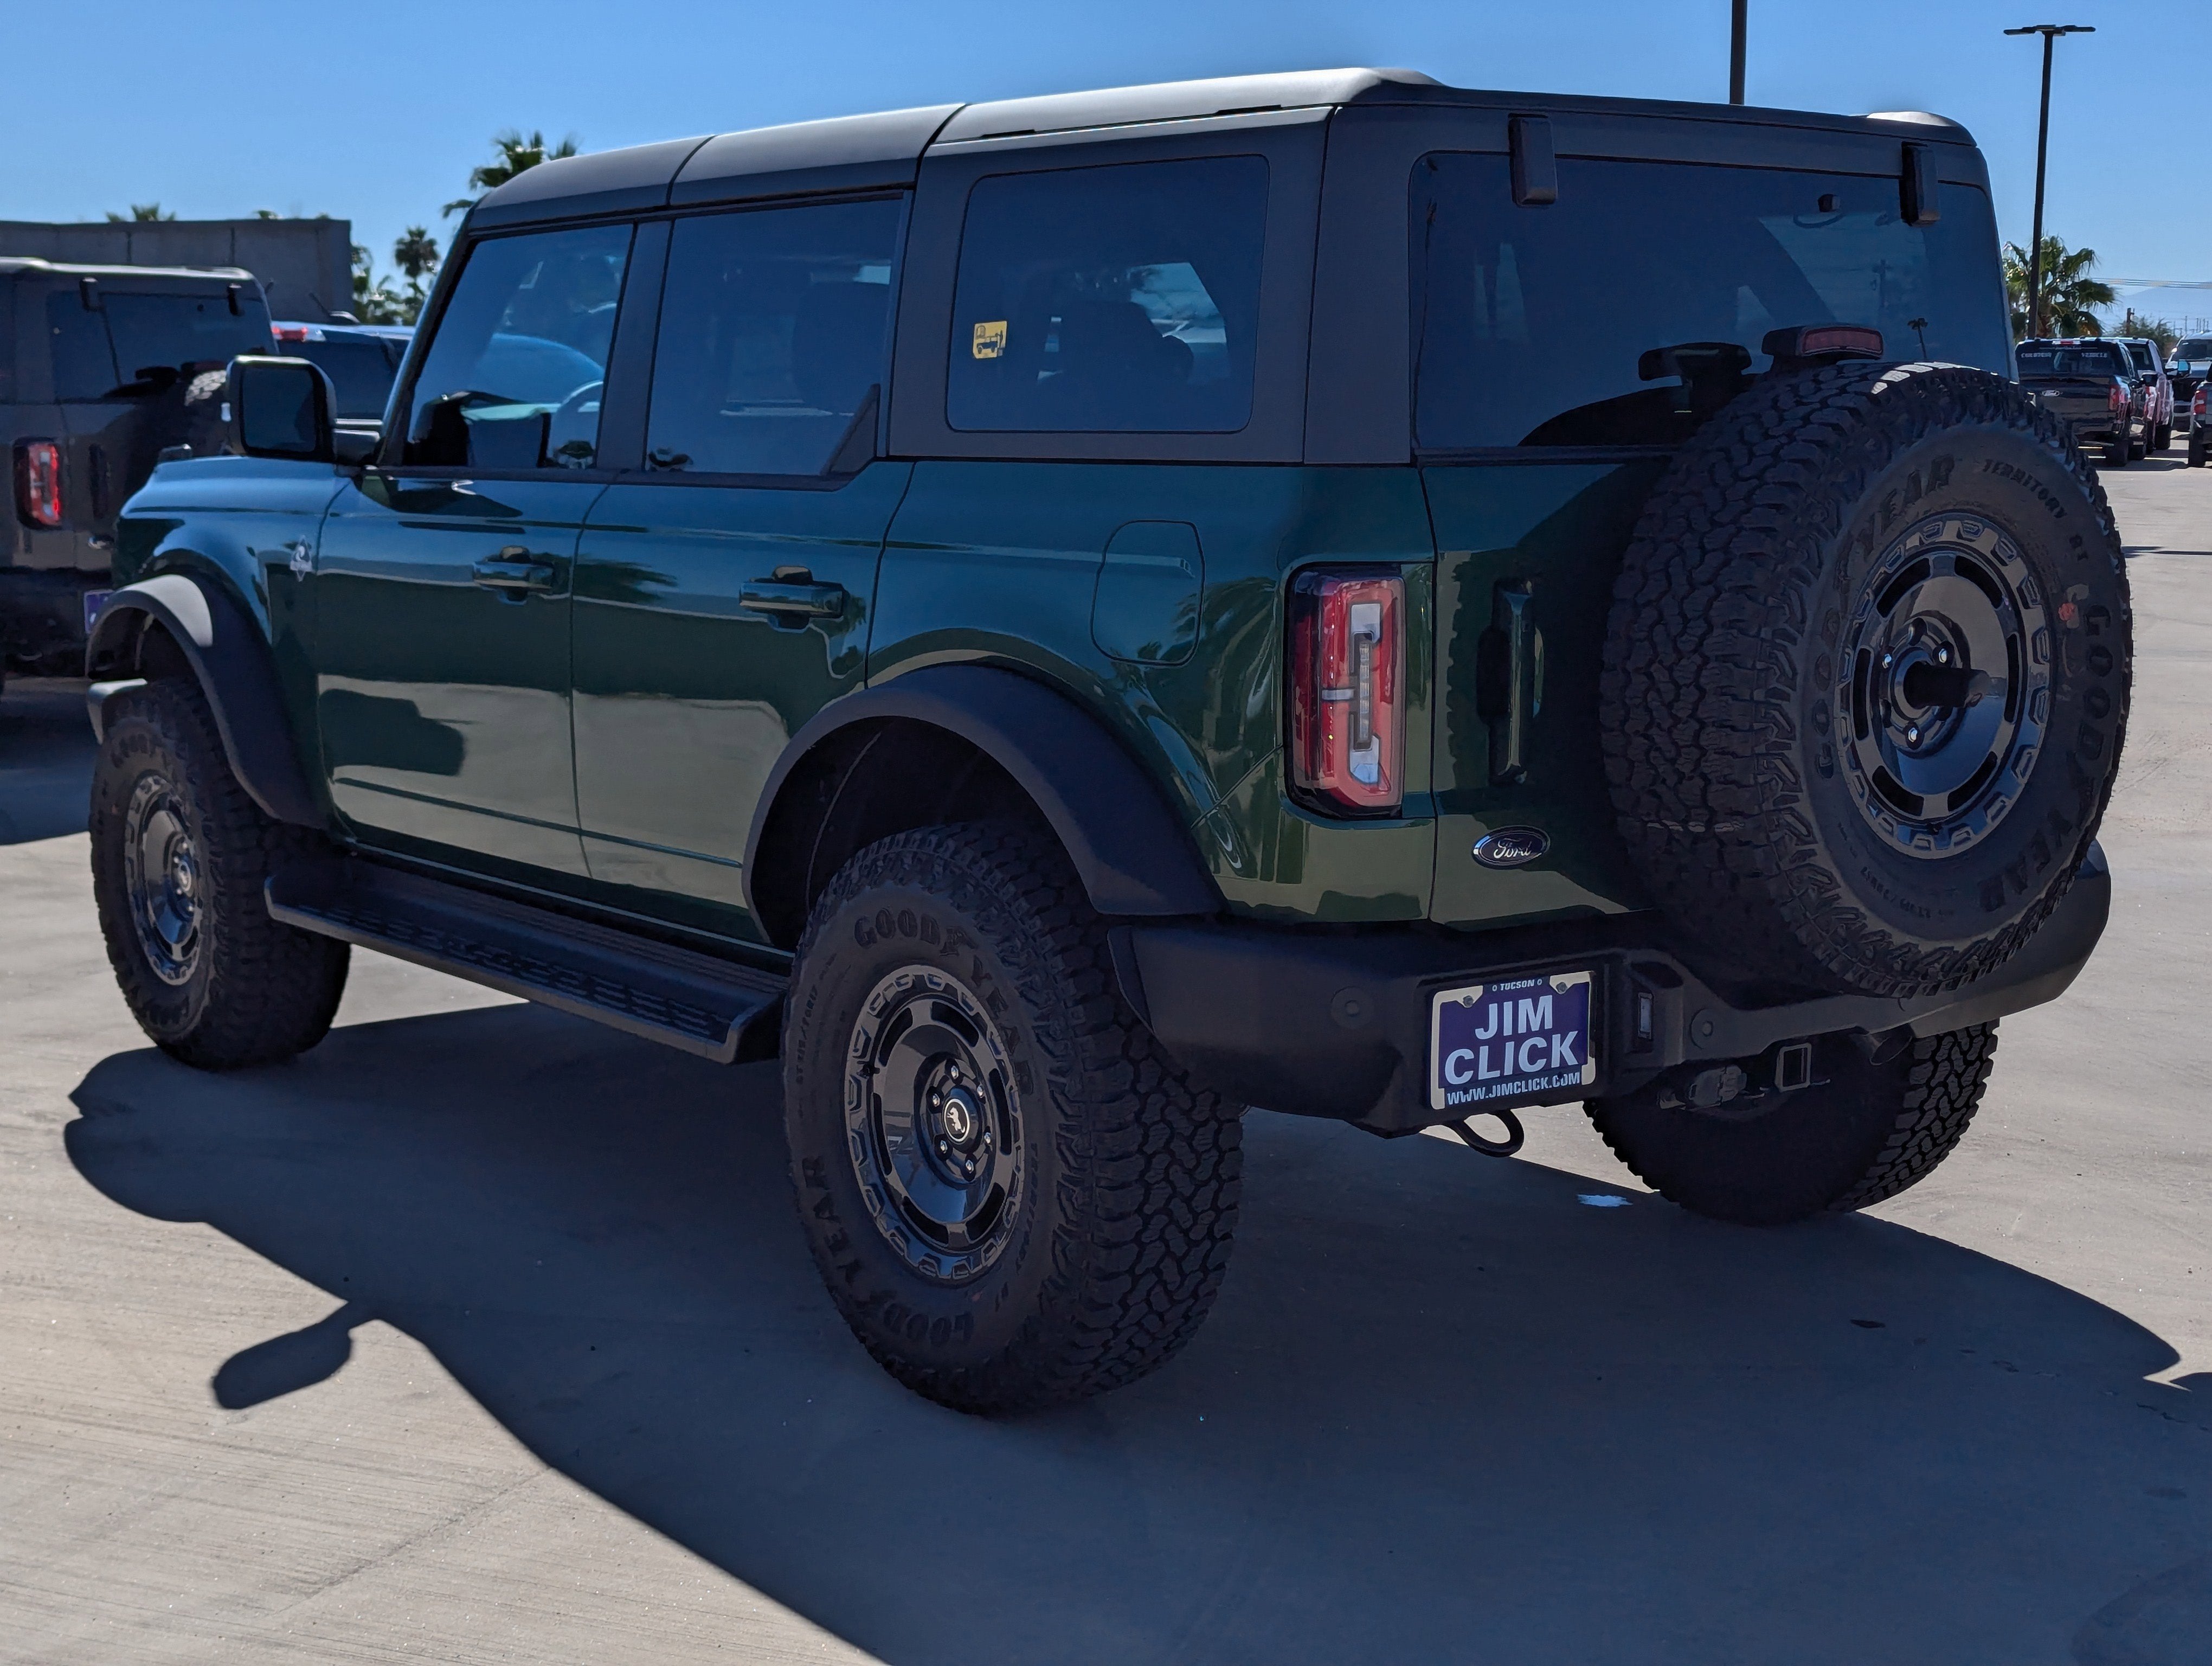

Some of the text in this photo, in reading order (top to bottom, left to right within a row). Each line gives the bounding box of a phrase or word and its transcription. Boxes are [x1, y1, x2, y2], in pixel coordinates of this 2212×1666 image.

[1494, 838, 1533, 858] Ford
[1500, 979, 1534, 991] TUCSON
[1475, 995, 1553, 1040] JIM
[1445, 1031, 1579, 1085] CLICK
[1446, 1072, 1580, 1105] WWW.JIMCLICK.COM
